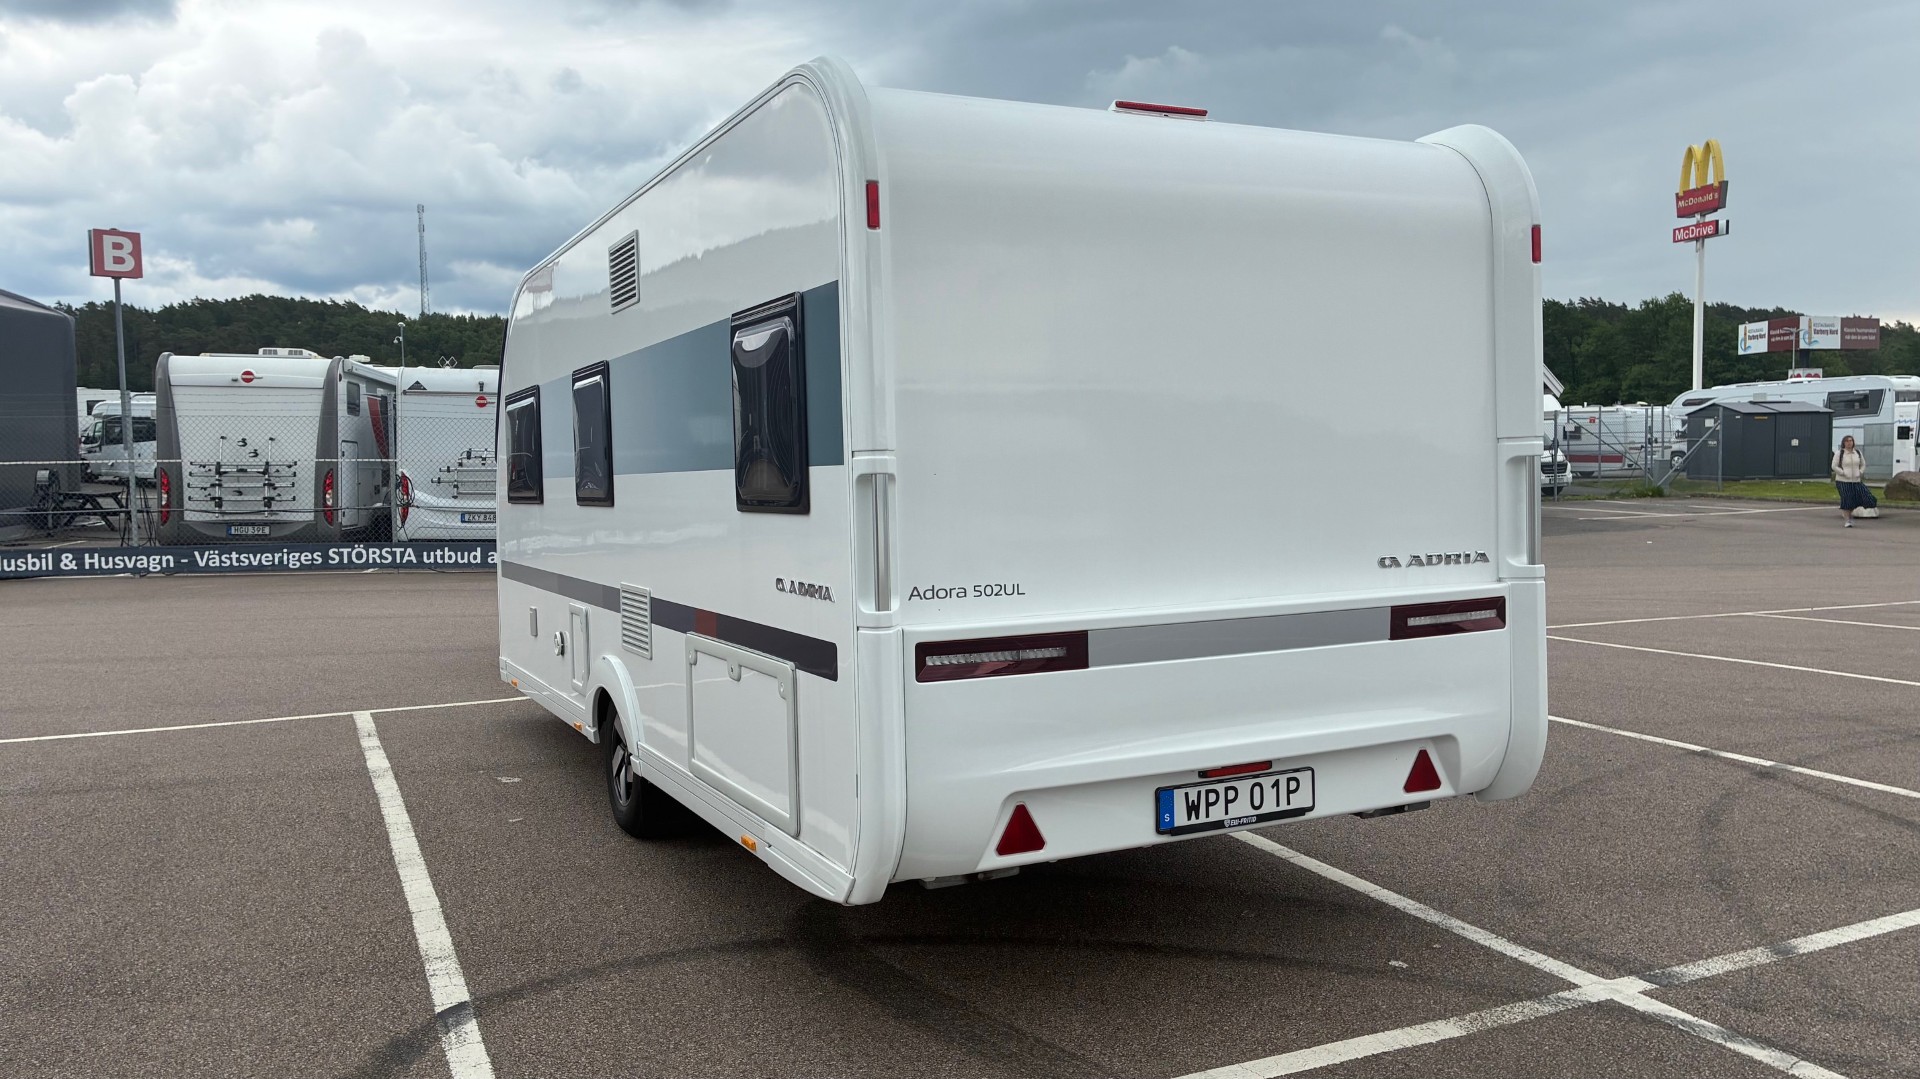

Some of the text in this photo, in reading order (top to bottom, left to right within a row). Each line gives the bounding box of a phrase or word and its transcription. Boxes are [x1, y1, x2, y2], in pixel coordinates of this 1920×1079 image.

[1677, 192, 1719, 209] McDonald's
[1674, 224, 1714, 241] McDrive
[102, 234, 136, 272] B
[234, 526, 249, 534] HGU
[0, 552, 53, 572] usbil
[59, 552, 78, 570] &
[84, 552, 175, 573] Husvagn
[194, 548, 323, 569] Västsveriges
[328, 543, 417, 564] STÖRSTA
[422, 546, 481, 564] utbud
[907, 583, 1026, 601] Adora 502UL
[1184, 776, 1301, 822] WPP 01P
[1164, 814, 1171, 822] S
